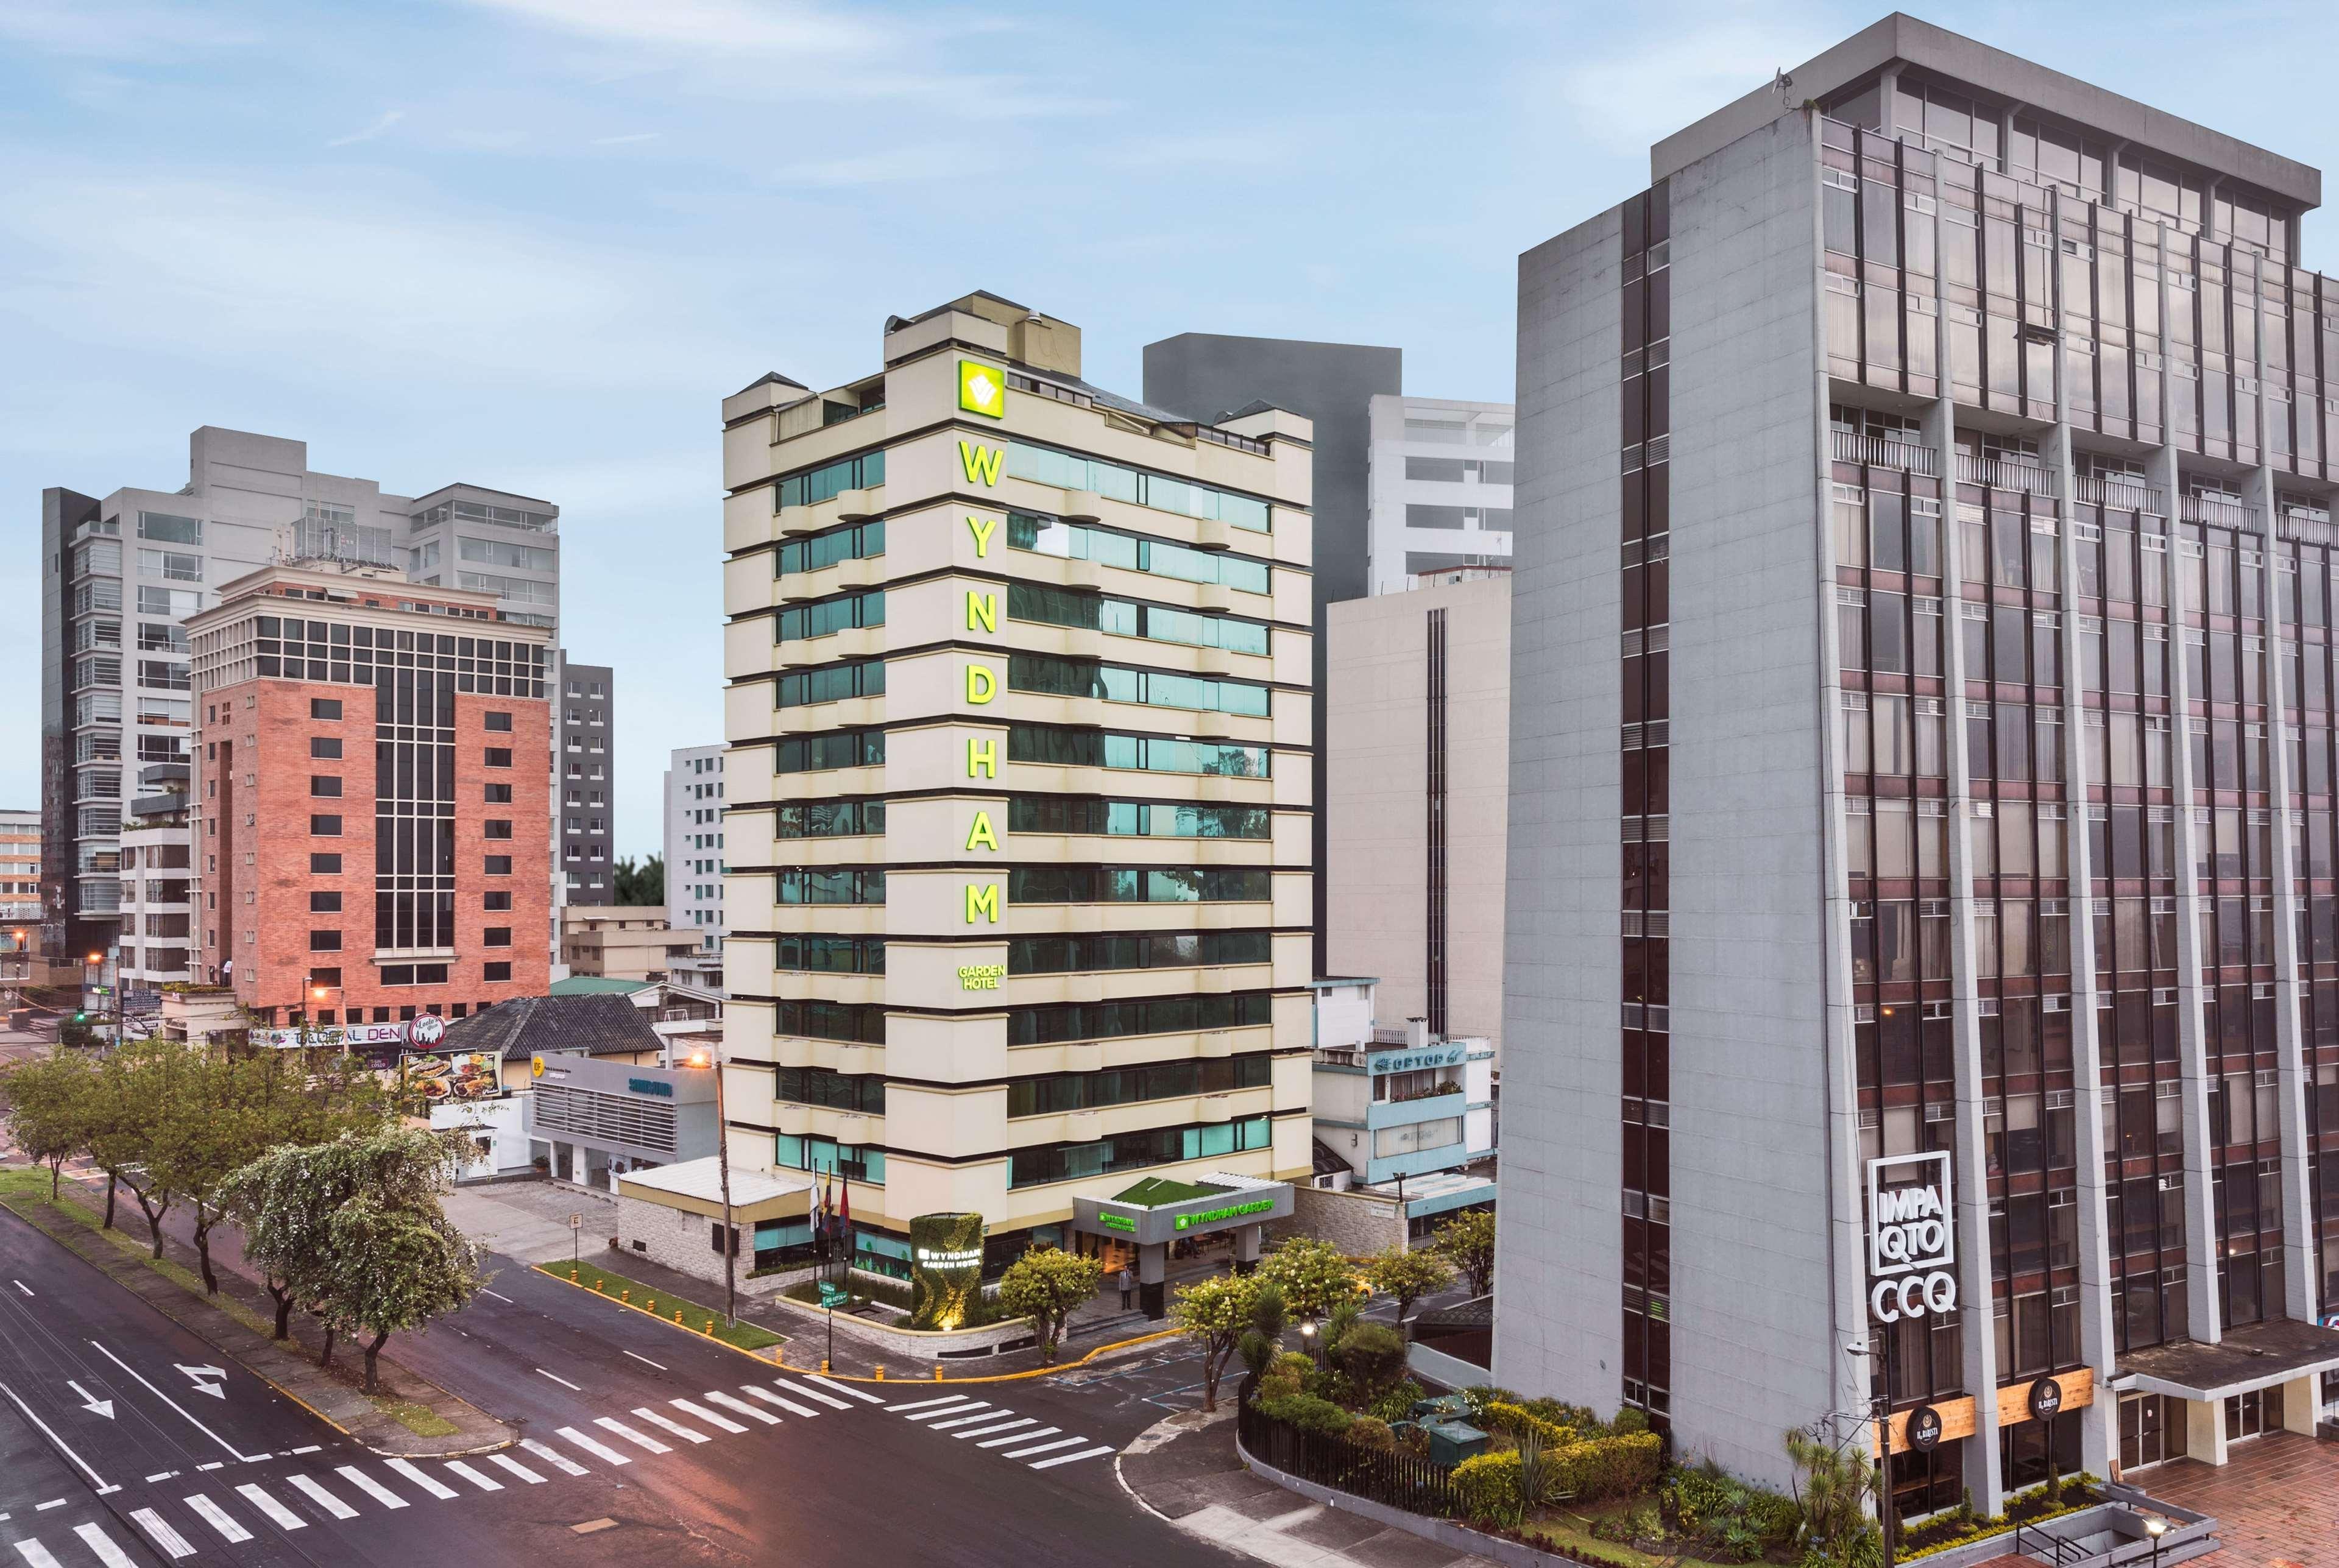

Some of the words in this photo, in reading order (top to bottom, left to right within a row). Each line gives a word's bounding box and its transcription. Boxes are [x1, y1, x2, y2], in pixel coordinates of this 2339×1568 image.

[959, 440, 1004, 923] WYNDHAM
[958, 965, 1005, 978] GARDEN
[963, 976, 1000, 990] HOTEL
[1189, 1206, 1237, 1226] WYNDHAM
[1238, 1199, 1274, 1215] GARDEN
[1878, 1185, 1944, 1223] IMPA
[930, 1248, 982, 1260] WYNDHAM
[1879, 1219, 1945, 1263] QTO
[956, 1258, 980, 1268] HOTEL
[1871, 1271, 1956, 1323] CCQ
